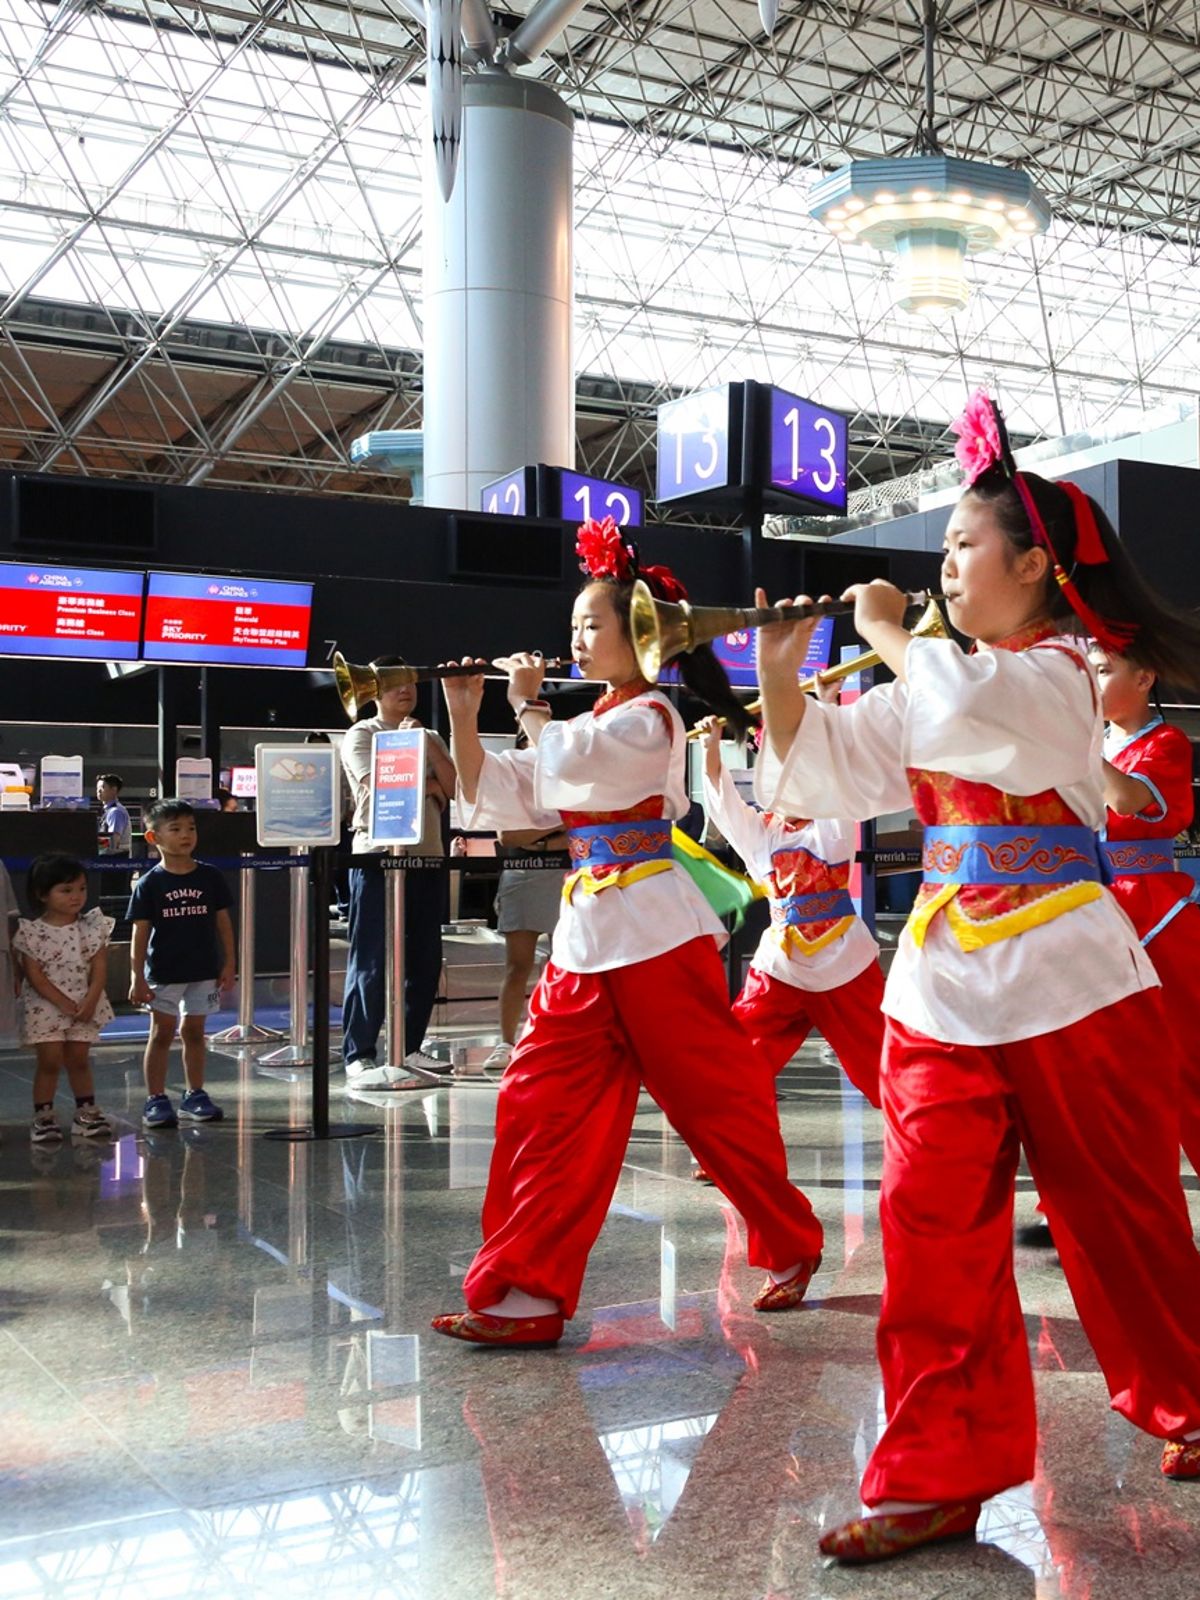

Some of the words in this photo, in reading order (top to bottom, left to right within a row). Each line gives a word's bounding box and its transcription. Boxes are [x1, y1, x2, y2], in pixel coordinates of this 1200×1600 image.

[674, 410, 718, 485] 13
[783, 407, 837, 493] 13
[57, 606, 87, 615] Premium
[88, 608, 117, 617] Business
[118, 609, 136, 617] Class
[55, 627, 85, 636] Business
[86, 629, 105, 637] Class
[162, 625, 182, 633] SKY
[161, 632, 207, 641] PRIORITY
[324, 639, 337, 661] 7
[379, 766, 395, 774] SKY
[379, 773, 415, 784] PRIORITY
[149, 787, 156, 797] 8
[380, 856, 423, 869] everrich
[503, 856, 544, 869] everrich
[165, 888, 203, 901] TOMMY
[163, 905, 208, 918] HILFIGER
